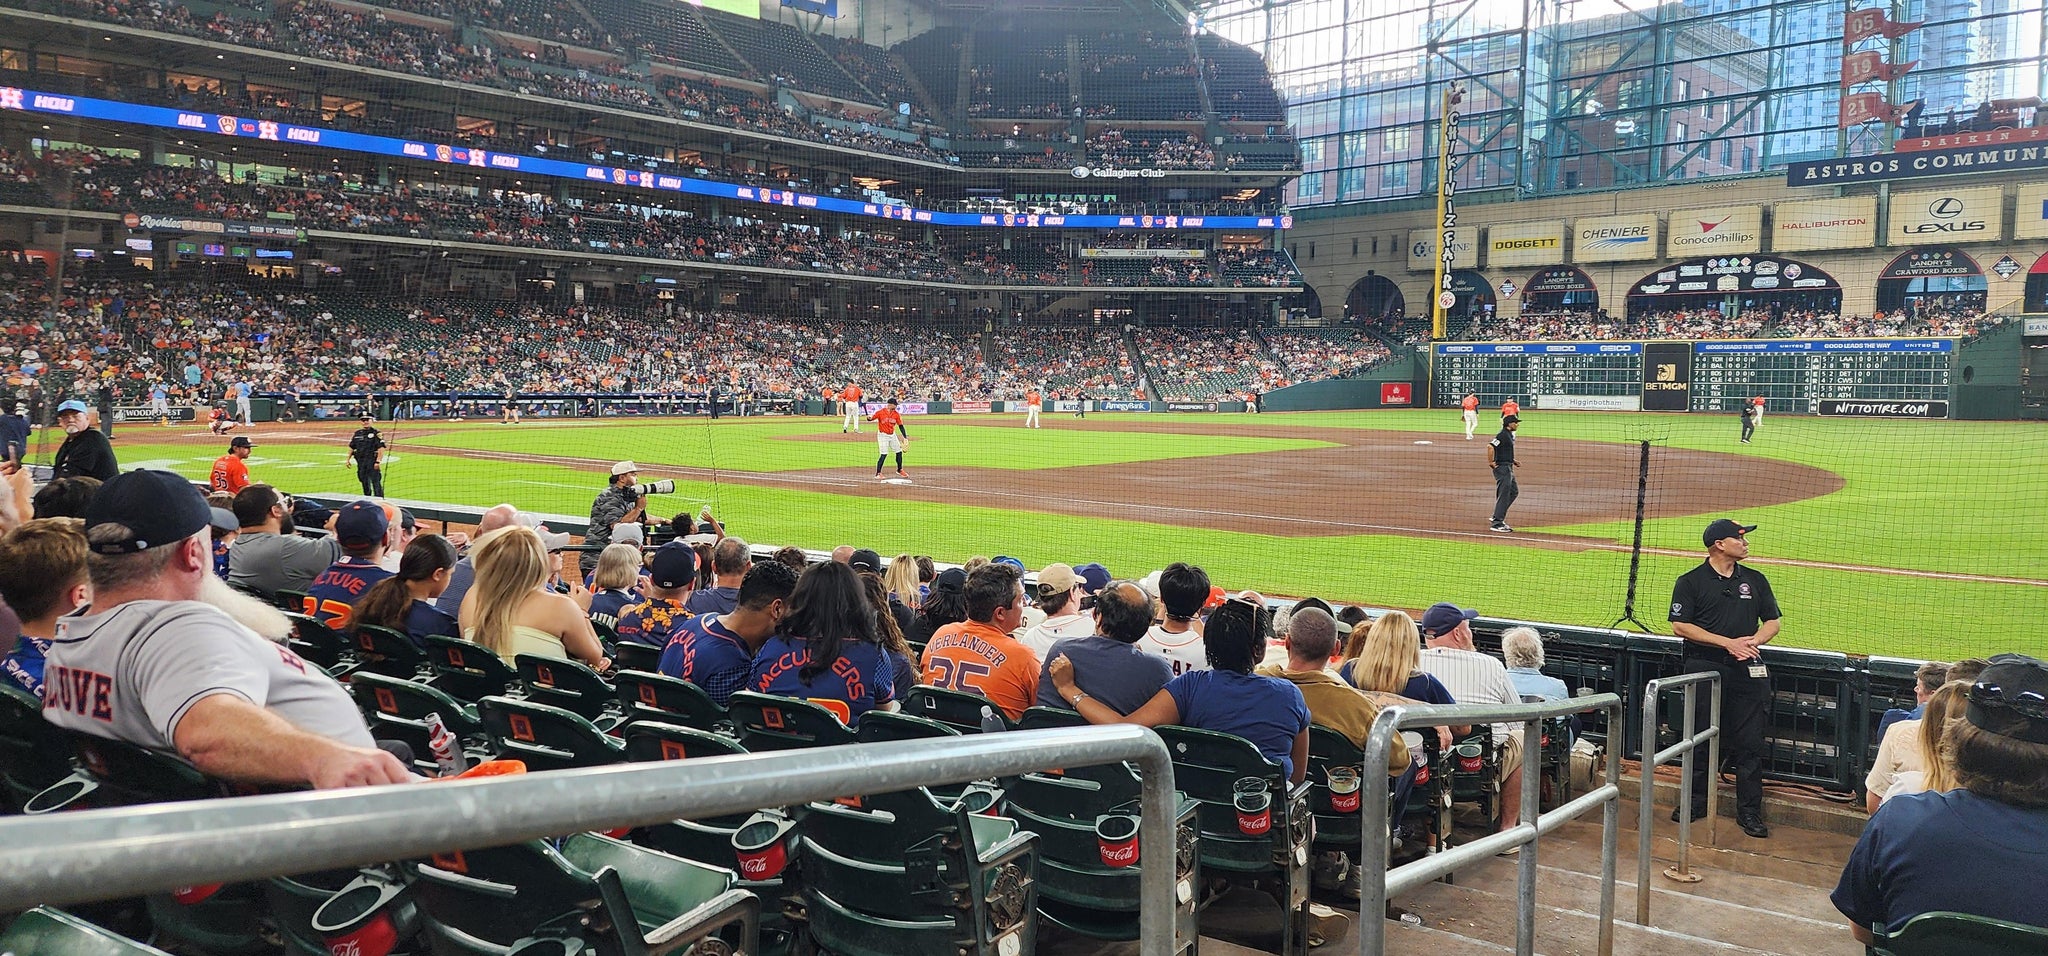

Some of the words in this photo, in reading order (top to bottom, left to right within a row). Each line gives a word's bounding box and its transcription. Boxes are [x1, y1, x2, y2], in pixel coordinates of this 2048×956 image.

[1852, 14, 1874, 34] 05
[1851, 58, 1871, 77] 19
[34, 95, 75, 112] HOU
[1847, 99, 1867, 117] 21
[177, 113, 207, 128] MIL
[286, 127, 320, 143] HOU
[1921, 131, 2011, 148] DAIKIN
[491, 155, 520, 168] HOU
[1092, 167, 1140, 179] Gallagher
[1140, 168, 1165, 178] Club
[1805, 159, 1899, 180] ASTROS
[140, 214, 182, 229] Rookies
[1782, 218, 1866, 230] HALLIBURTON
[1903, 220, 1986, 234] LEXUS
[1582, 225, 1650, 239] CHENIERE
[1673, 232, 1754, 246] ConocoPhillips
[1495, 238, 1556, 250] DOGGETT
[1909, 259, 1952, 268] LANDRY'S
[1895, 267, 1940, 276] CRAWFORD
[1942, 266, 1968, 275] BOXES
[1416, 345, 1430, 353] 315
[1645, 382, 1687, 390] BETMGM
[1810, 357, 1819, 411] AMERICAN
[1063, 402, 1080, 411] kanz
[1105, 401, 1145, 411] AmegyBank
[1569, 399, 1622, 407] Higginbotham
[1835, 402, 1929, 416] NITTOTIRE.COM
[214, 470, 228, 489] 35
[929, 633, 1007, 669] VERLANDER
[929, 655, 991, 698] 35
[1100, 845, 1134, 860] Coca-Cola
[1005, 938, 1013, 955] 8
